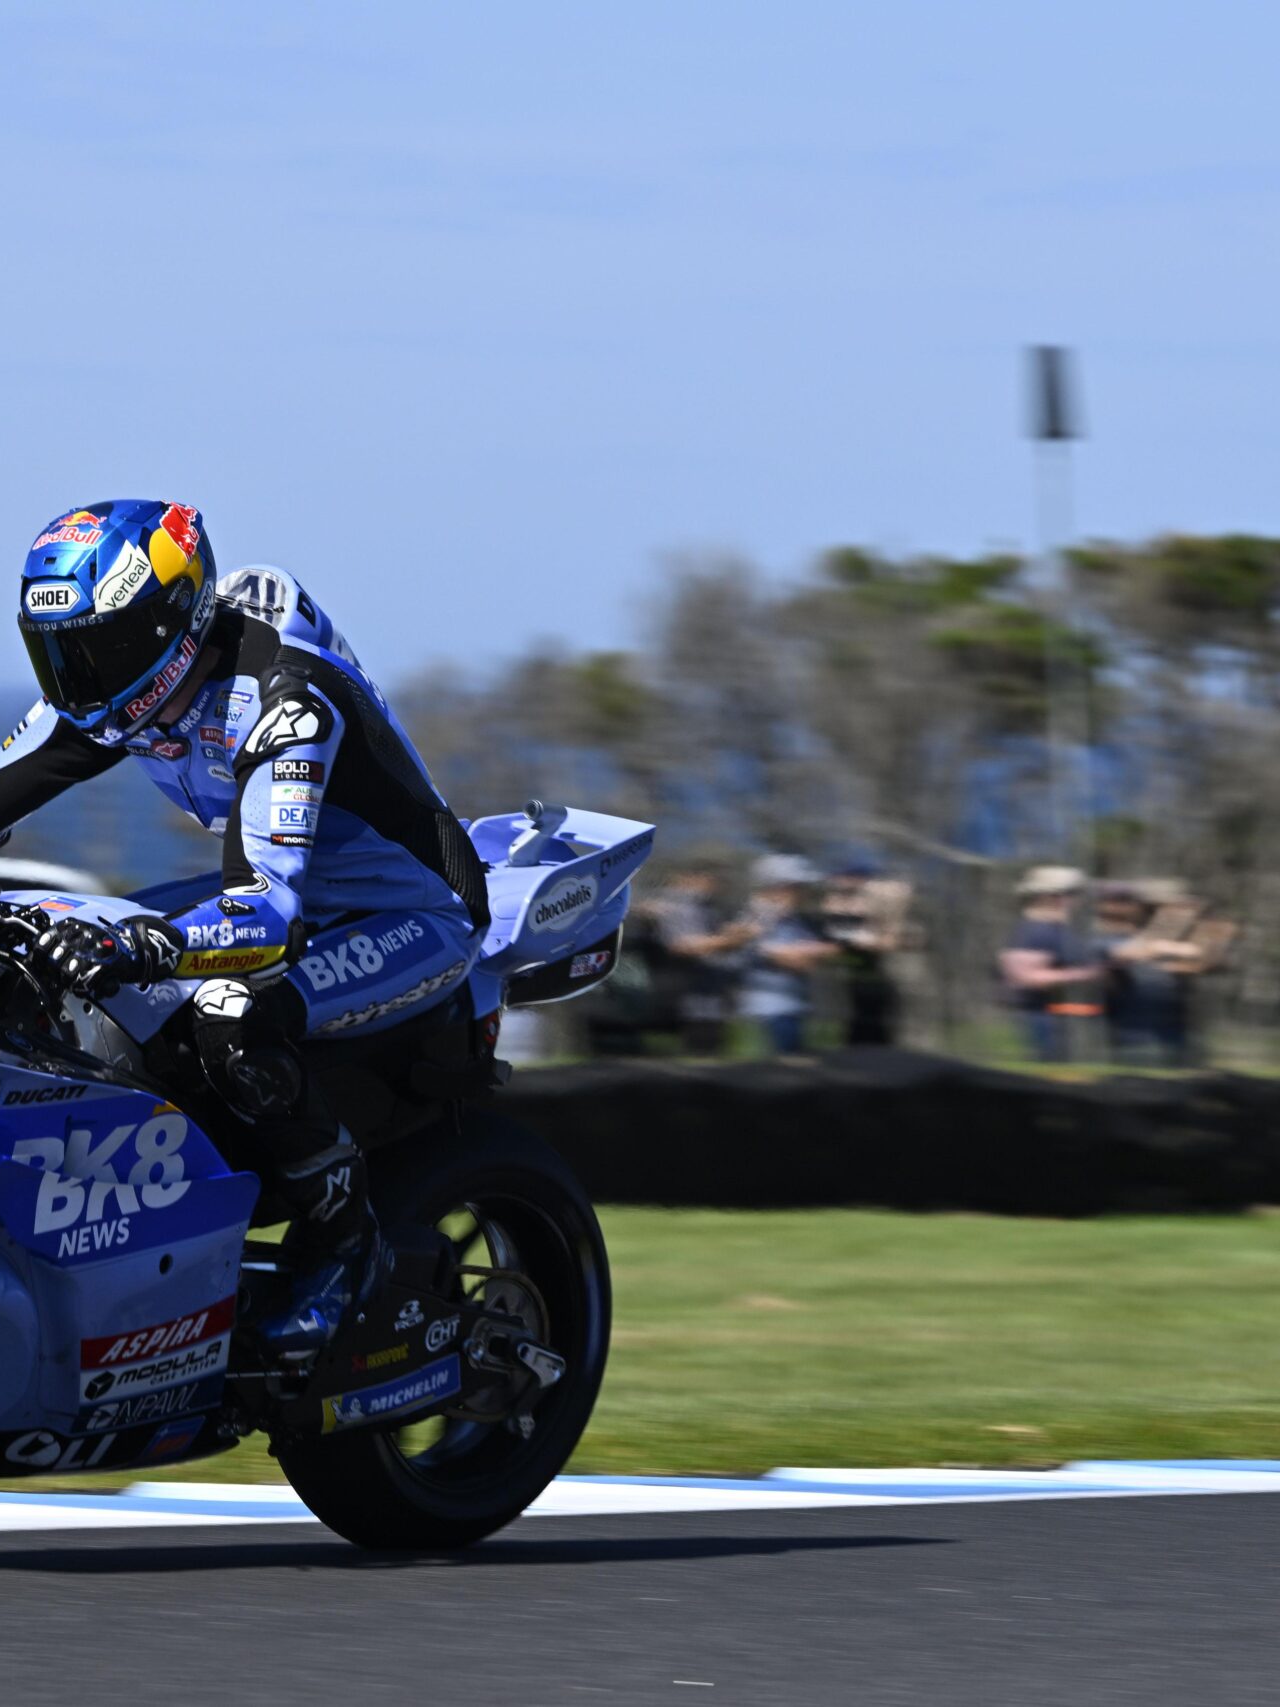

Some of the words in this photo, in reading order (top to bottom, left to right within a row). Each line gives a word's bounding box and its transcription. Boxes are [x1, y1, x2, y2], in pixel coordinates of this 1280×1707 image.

[61, 527, 103, 545] Bull
[31, 590, 69, 607] SHOEI
[104, 558, 150, 608] verleal
[37, 621, 58, 632] YOU
[63, 616, 105, 629] WINGS
[125, 674, 171, 720] Red
[162, 635, 197, 685] Bull
[178, 707, 202, 733] BK8
[274, 762, 310, 774] BOLD
[186, 923, 235, 948] BK8
[235, 927, 267, 940] NEWS
[186, 951, 265, 970] Antangin
[298, 934, 384, 992] BK8
[376, 919, 424, 956] NEWS
[2, 1084, 89, 1106] DUCATI
[12, 1113, 192, 1235] BK8
[58, 1218, 130, 1258] NEWS
[99, 1311, 209, 1364] ASPIRA
[117, 1340, 222, 1386] MODULA
[370, 1369, 449, 1414] MICHELIN
